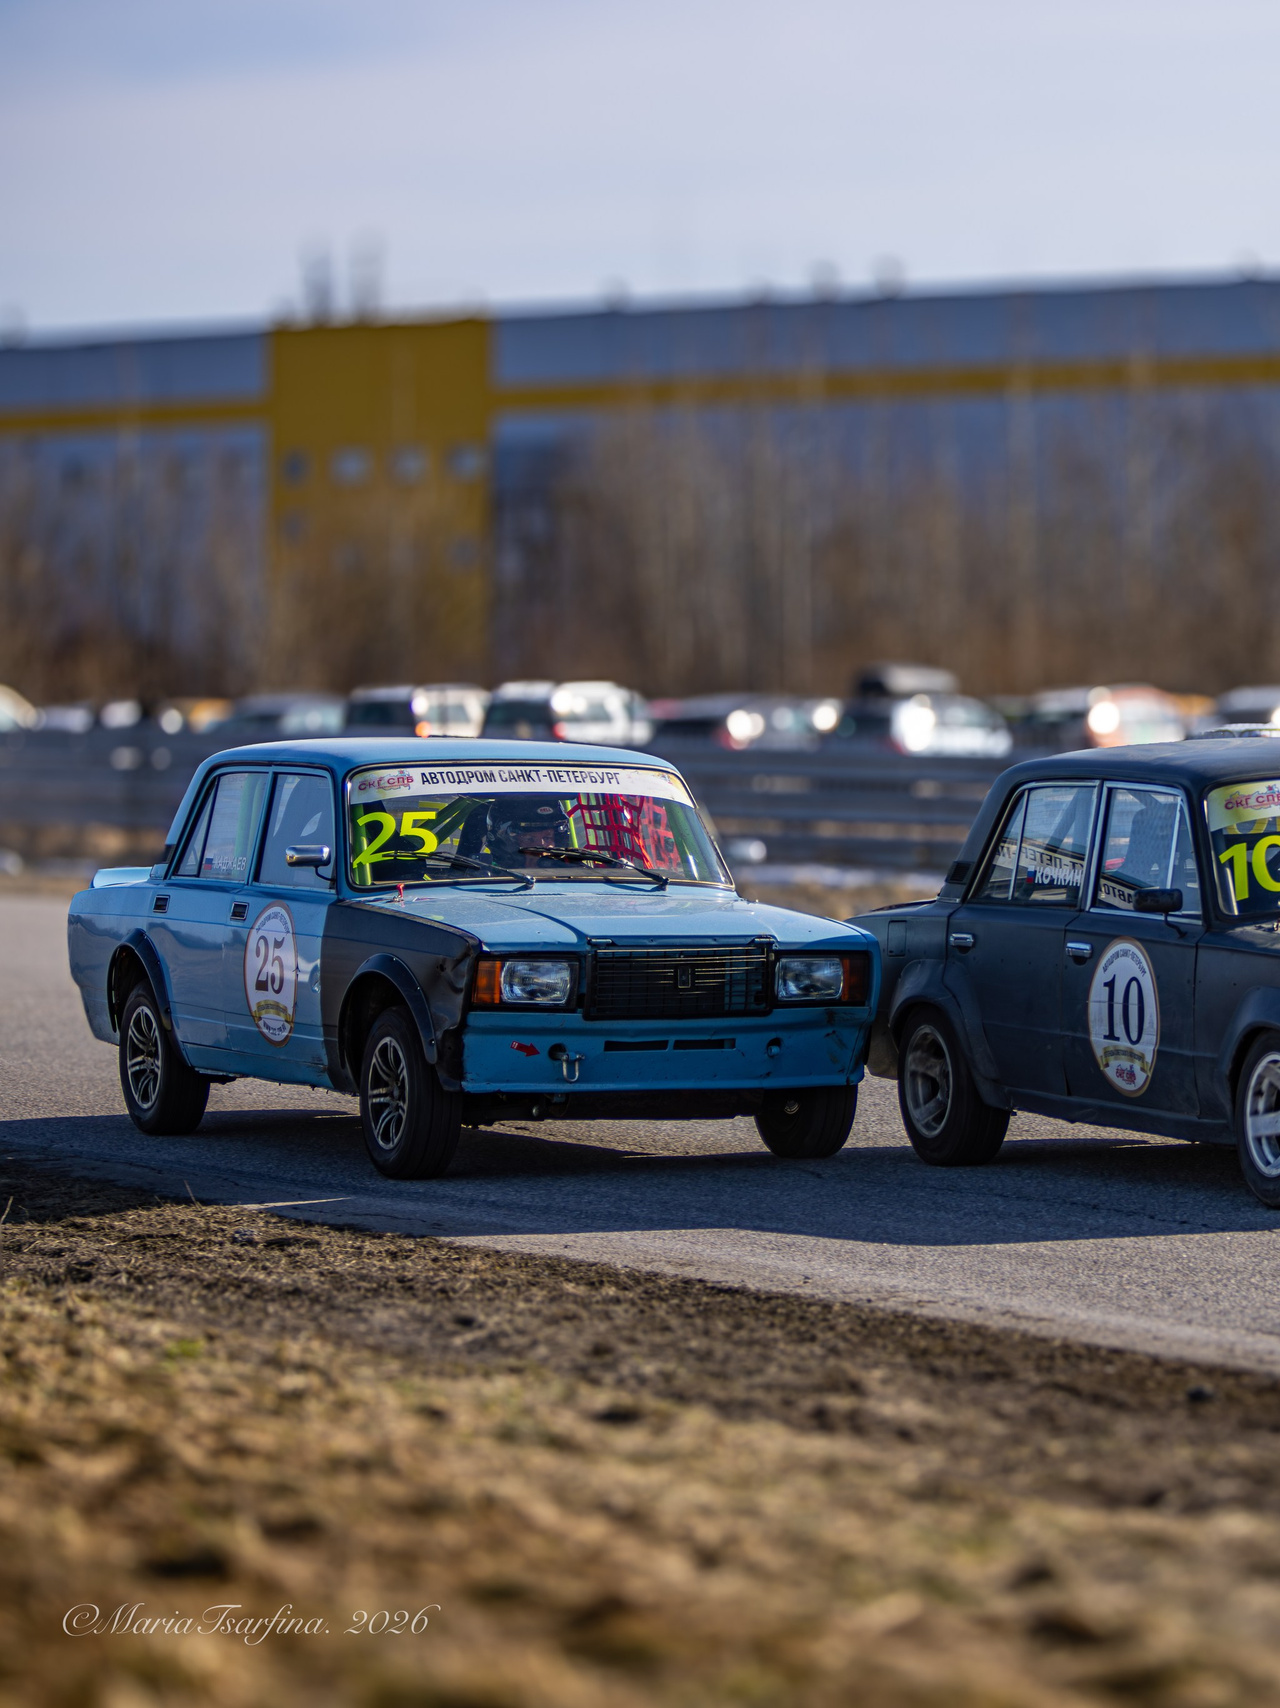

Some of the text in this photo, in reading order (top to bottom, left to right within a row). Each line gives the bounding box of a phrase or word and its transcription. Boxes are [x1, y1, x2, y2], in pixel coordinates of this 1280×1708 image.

[358, 775, 414, 791] СКГ СПБ
[420, 769, 621, 786] АВТОДРОМ САНКТ-ПЕТЕРБУРГ
[1224, 797, 1252, 811] СКГ
[353, 811, 439, 869] 25
[1035, 866, 1083, 886] КОЧКИН
[255, 935, 285, 994] 25
[1103, 974, 1145, 1045] 10
